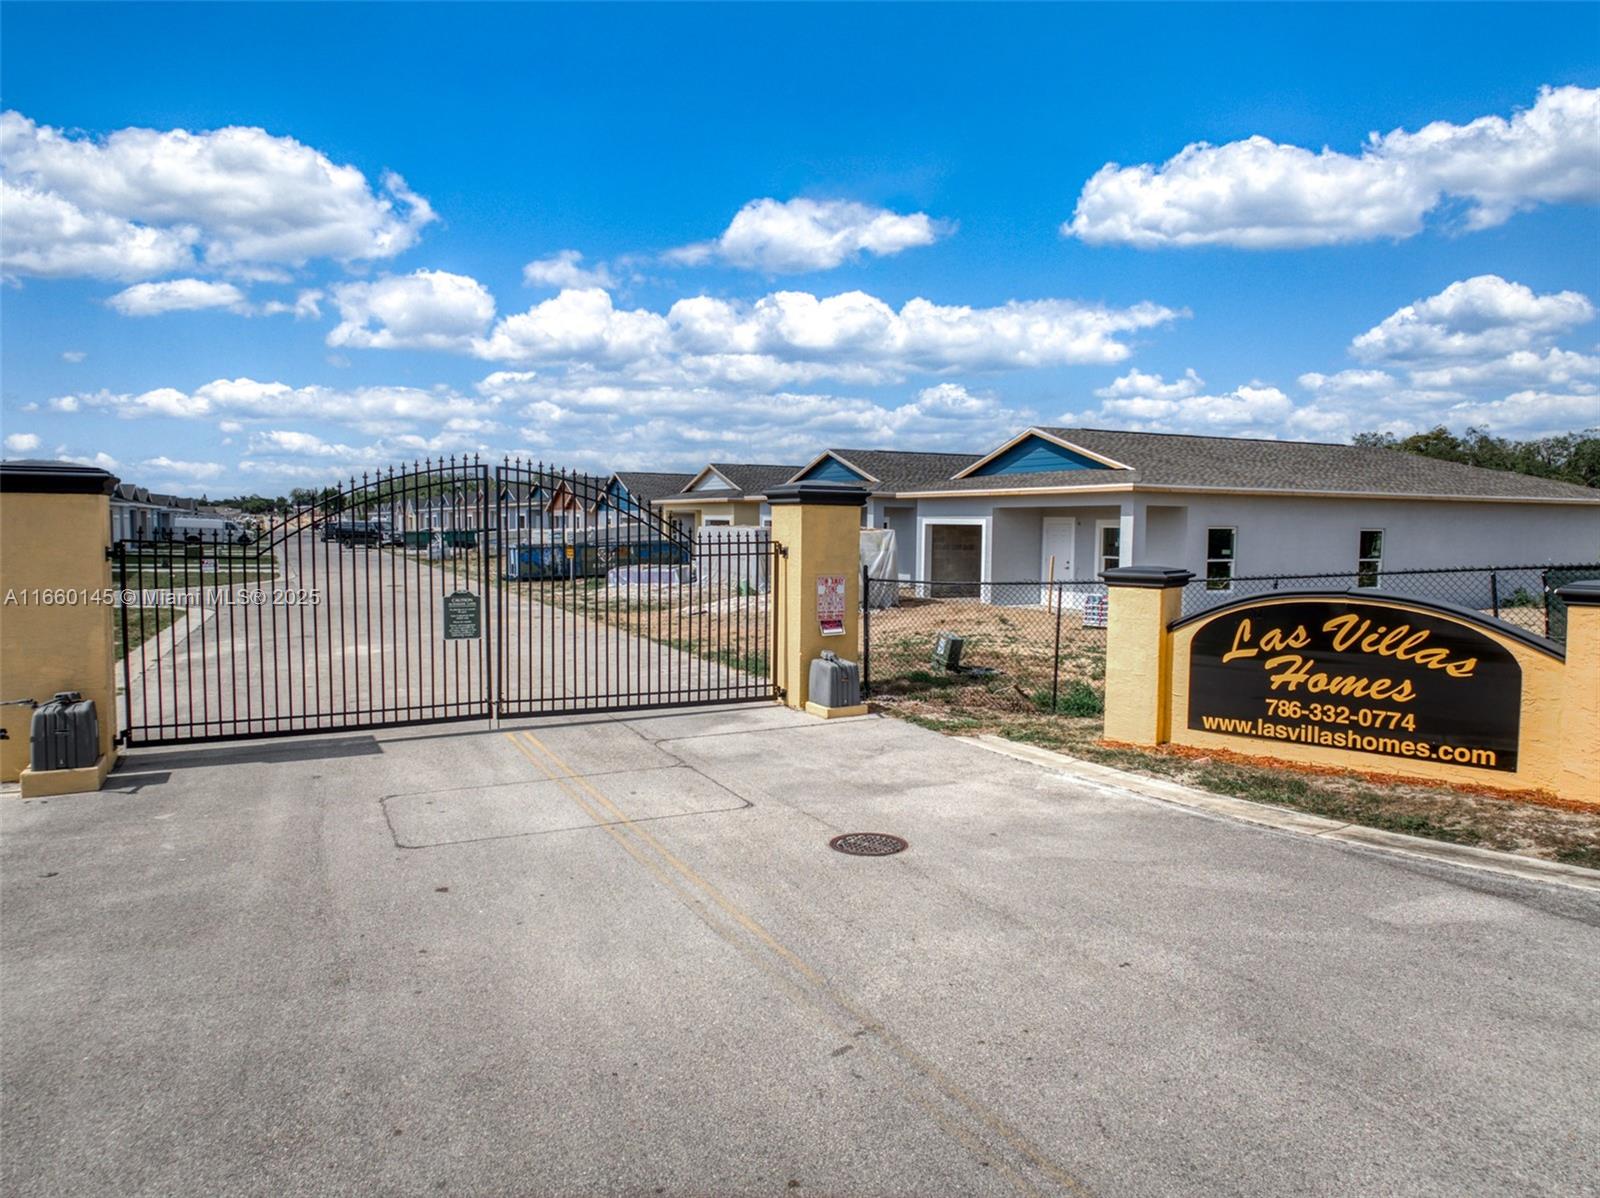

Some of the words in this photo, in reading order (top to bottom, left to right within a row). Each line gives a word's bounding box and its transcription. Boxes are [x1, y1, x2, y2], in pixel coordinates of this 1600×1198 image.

[1222, 618, 1311, 663] Las
[1322, 613, 1478, 678] Villas
[1264, 654, 1416, 702] Homes
[1265, 698, 1416, 732] 786-332-0774
[1202, 715, 1496, 766] www.lasvillashomes.com
